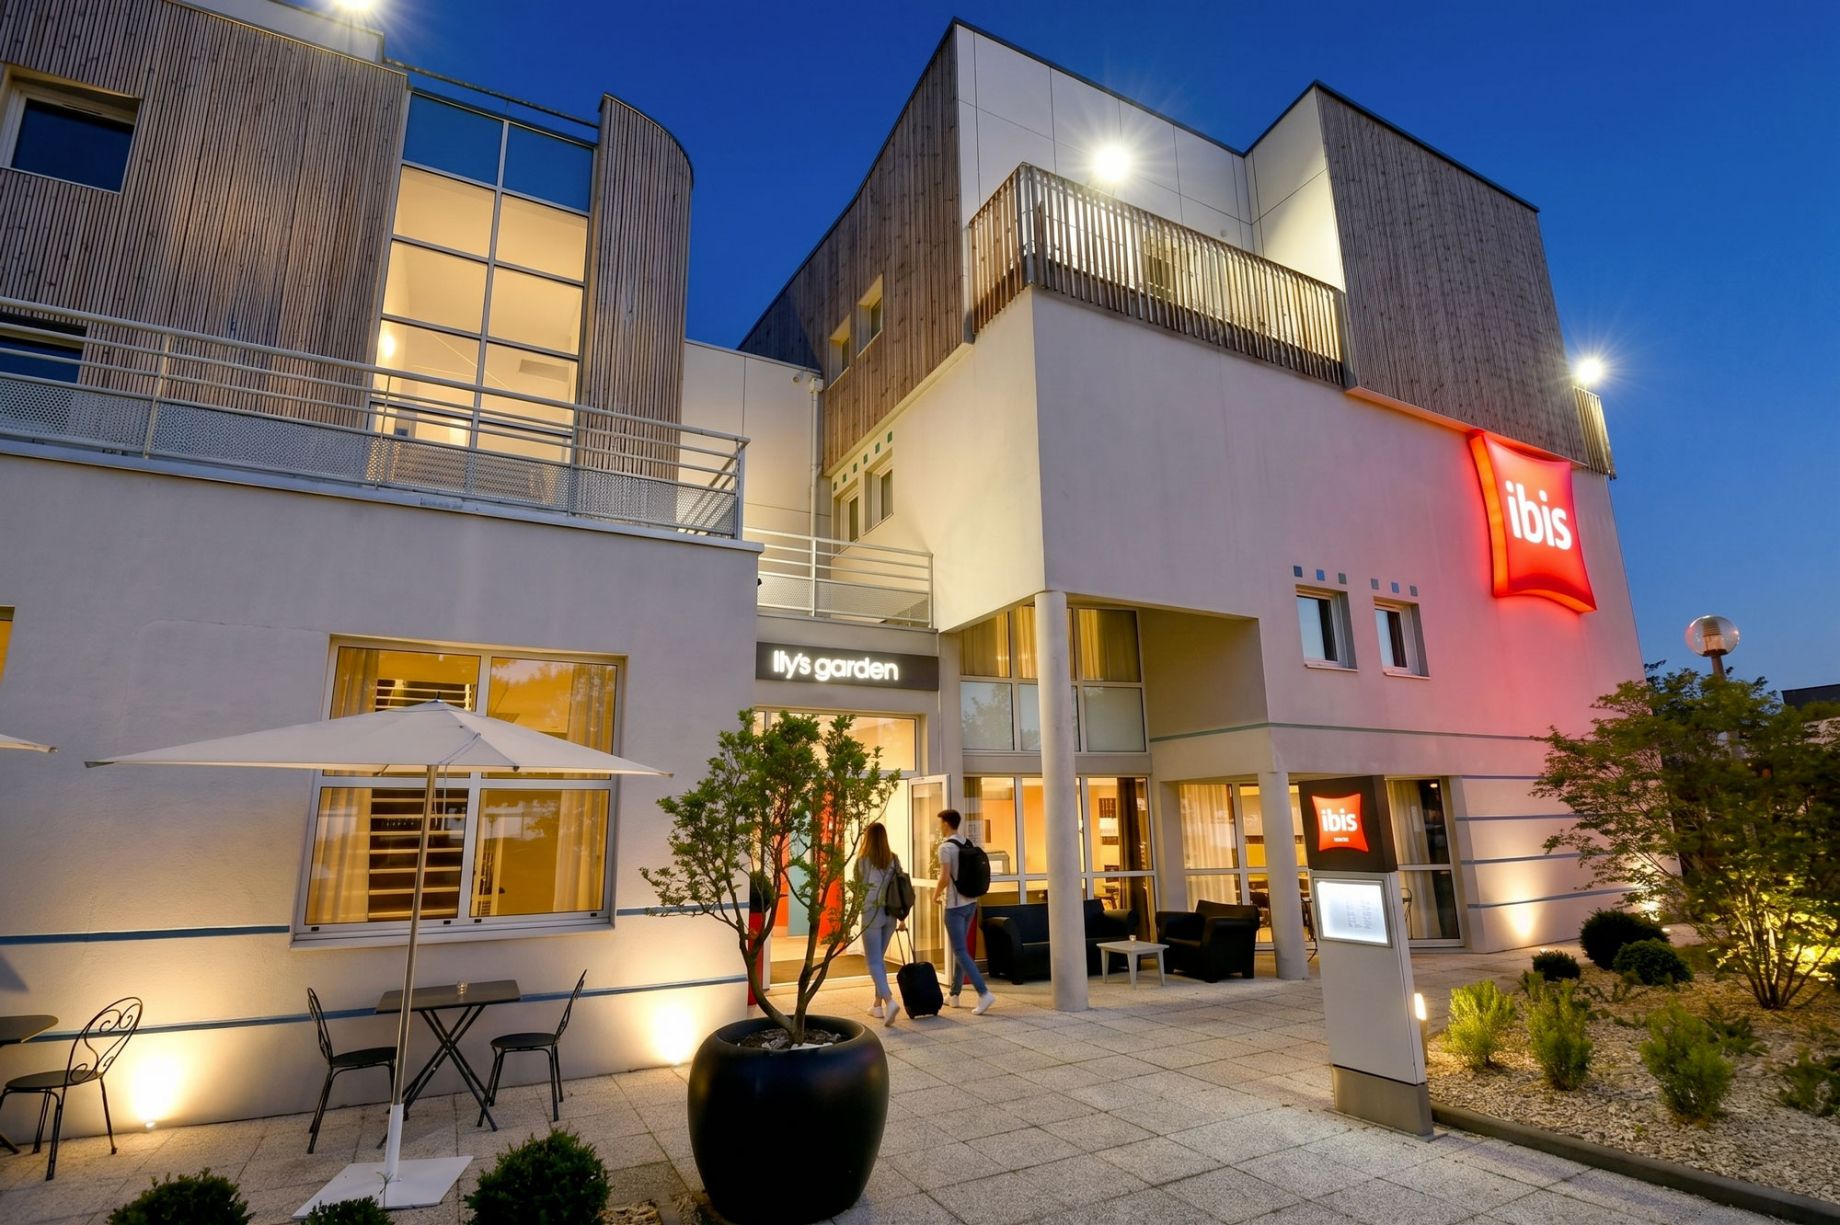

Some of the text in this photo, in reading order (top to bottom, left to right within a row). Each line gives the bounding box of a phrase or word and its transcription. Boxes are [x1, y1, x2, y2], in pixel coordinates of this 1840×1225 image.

[1505, 480, 1572, 551] ibis
[814, 657, 899, 682] garden
[1321, 808, 1358, 833] ibis
